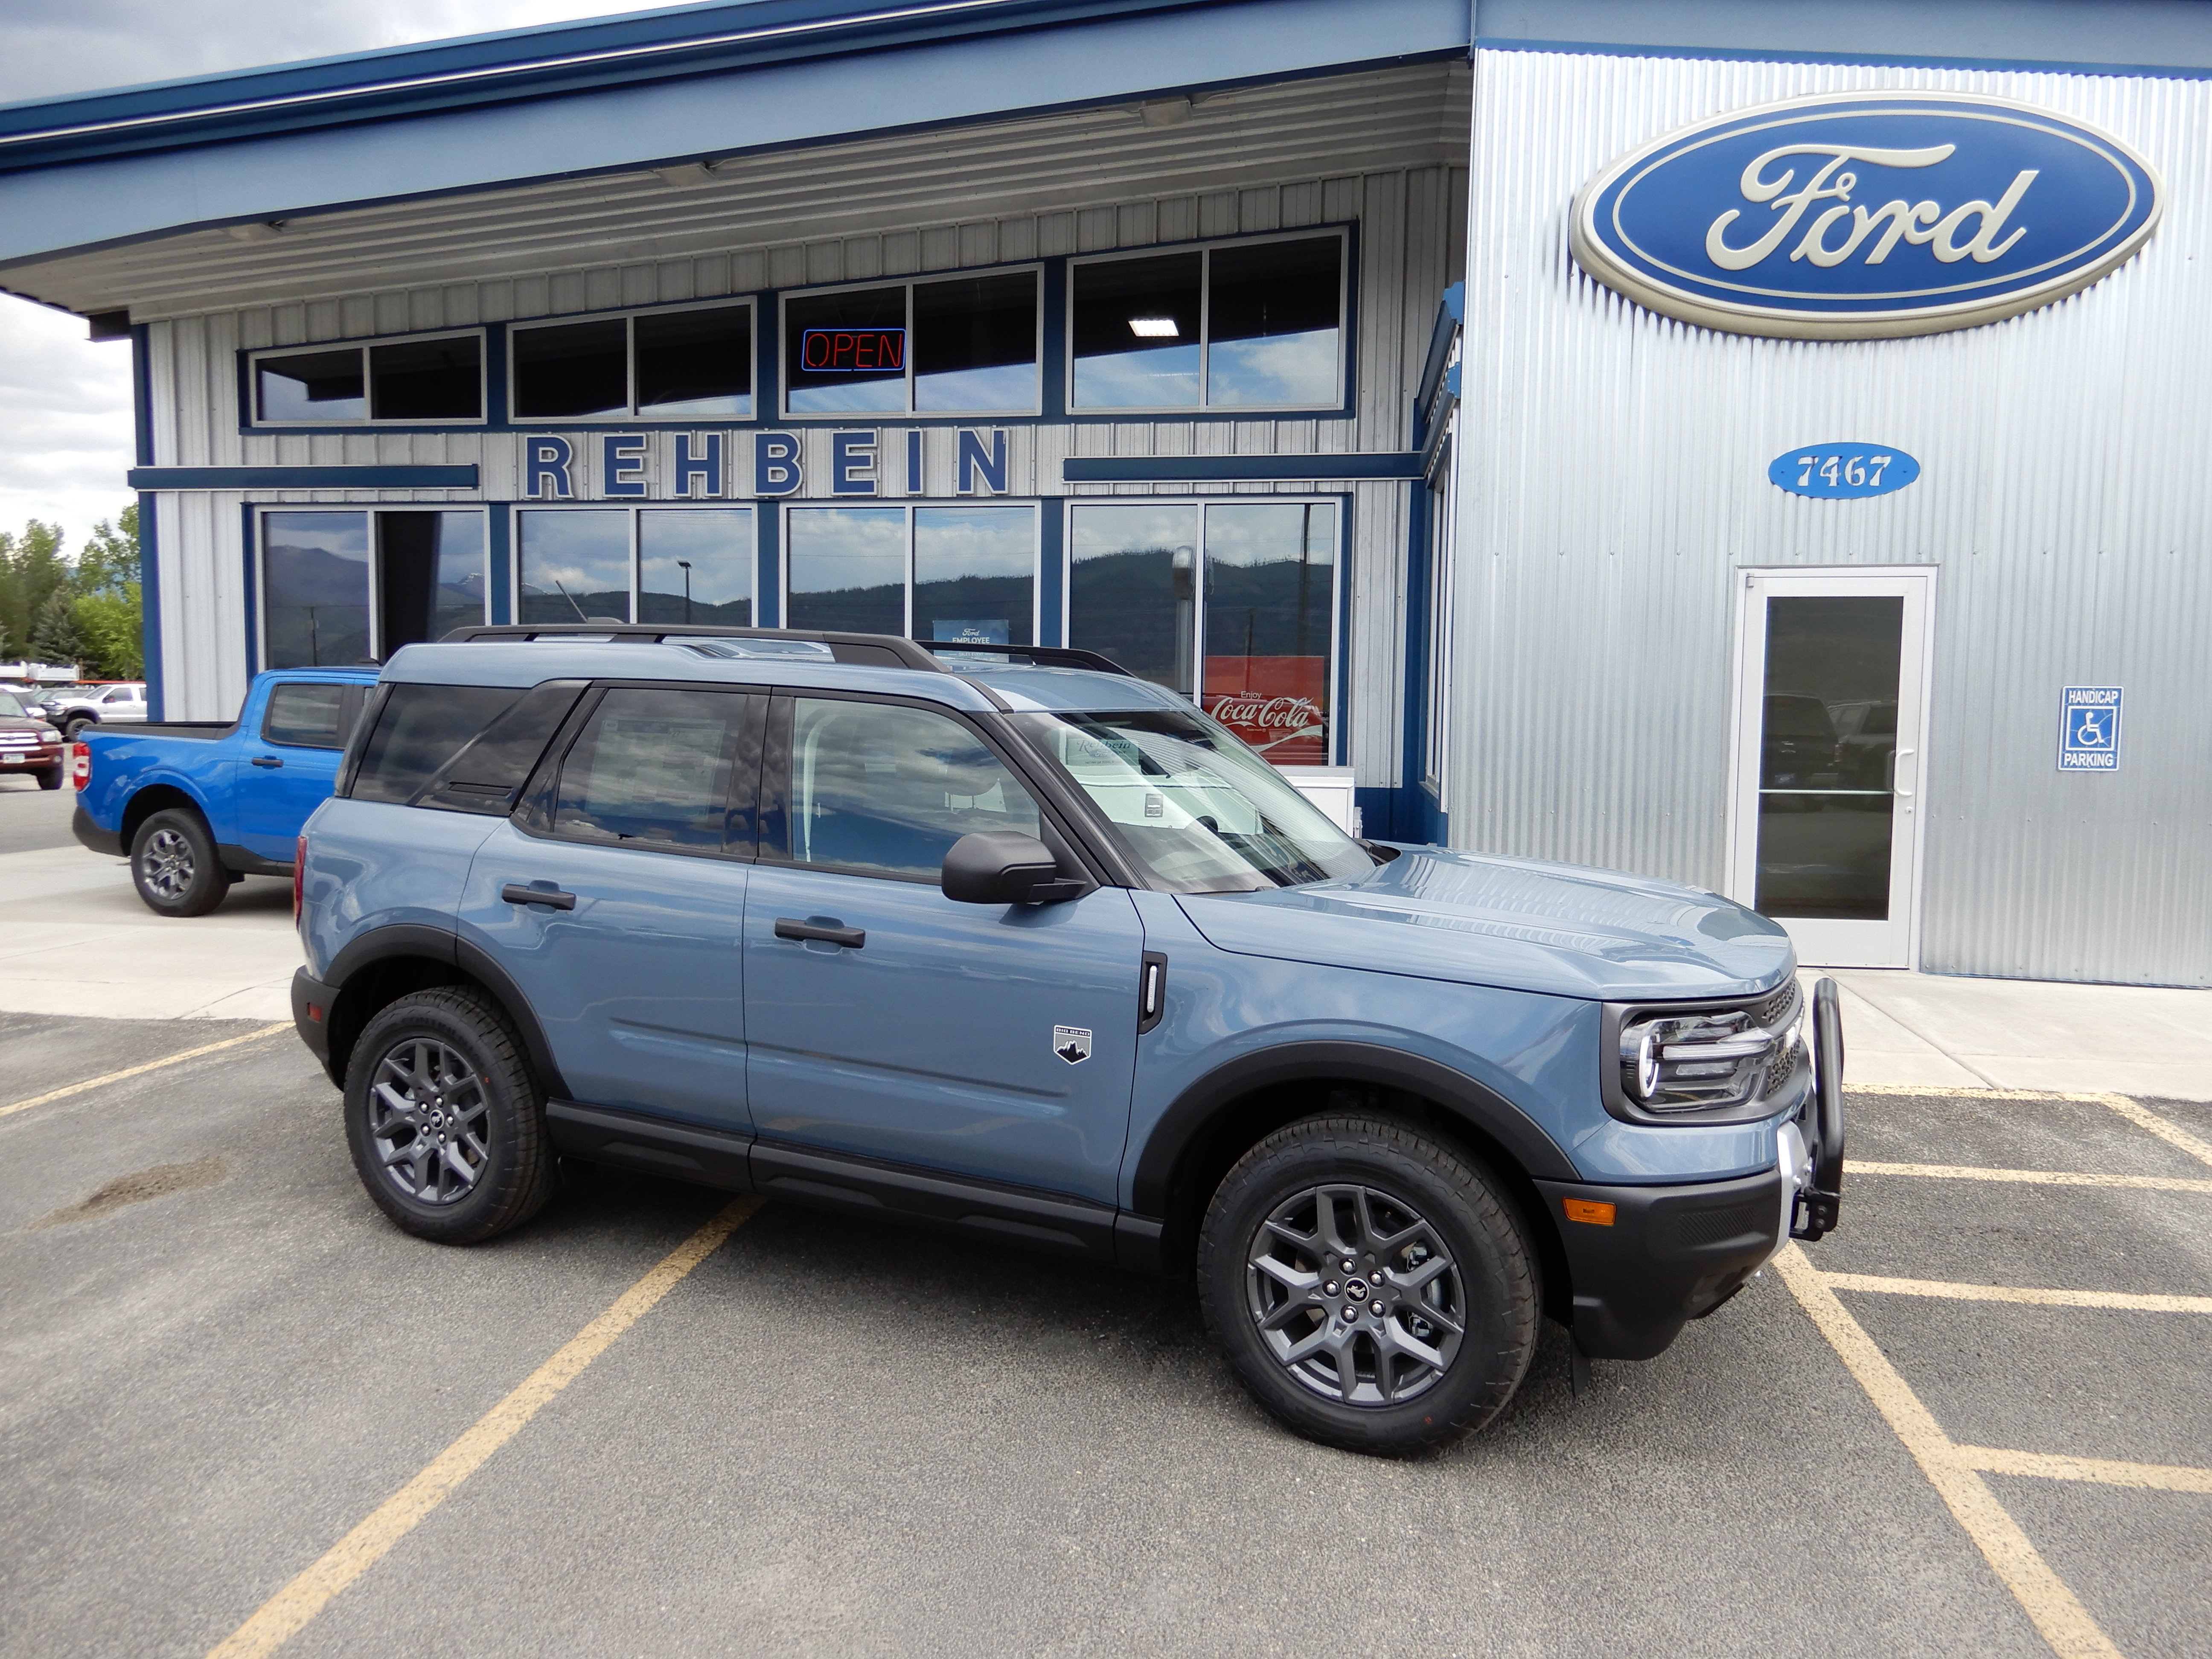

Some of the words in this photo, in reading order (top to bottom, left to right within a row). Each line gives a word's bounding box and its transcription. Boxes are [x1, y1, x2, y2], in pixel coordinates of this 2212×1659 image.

[1706, 143, 2039, 270] Ford
[805, 333, 902, 368] OPEN
[525, 428, 1010, 499] REHBEIN
[1797, 456, 1892, 487] 7467
[962, 628, 980, 636] Ford
[1241, 691, 1262, 699] Enjoy
[2069, 690, 2118, 704] HANDICAP
[1211, 697, 1314, 727] Coca-Cola
[2064, 753, 2113, 766] PARKING
